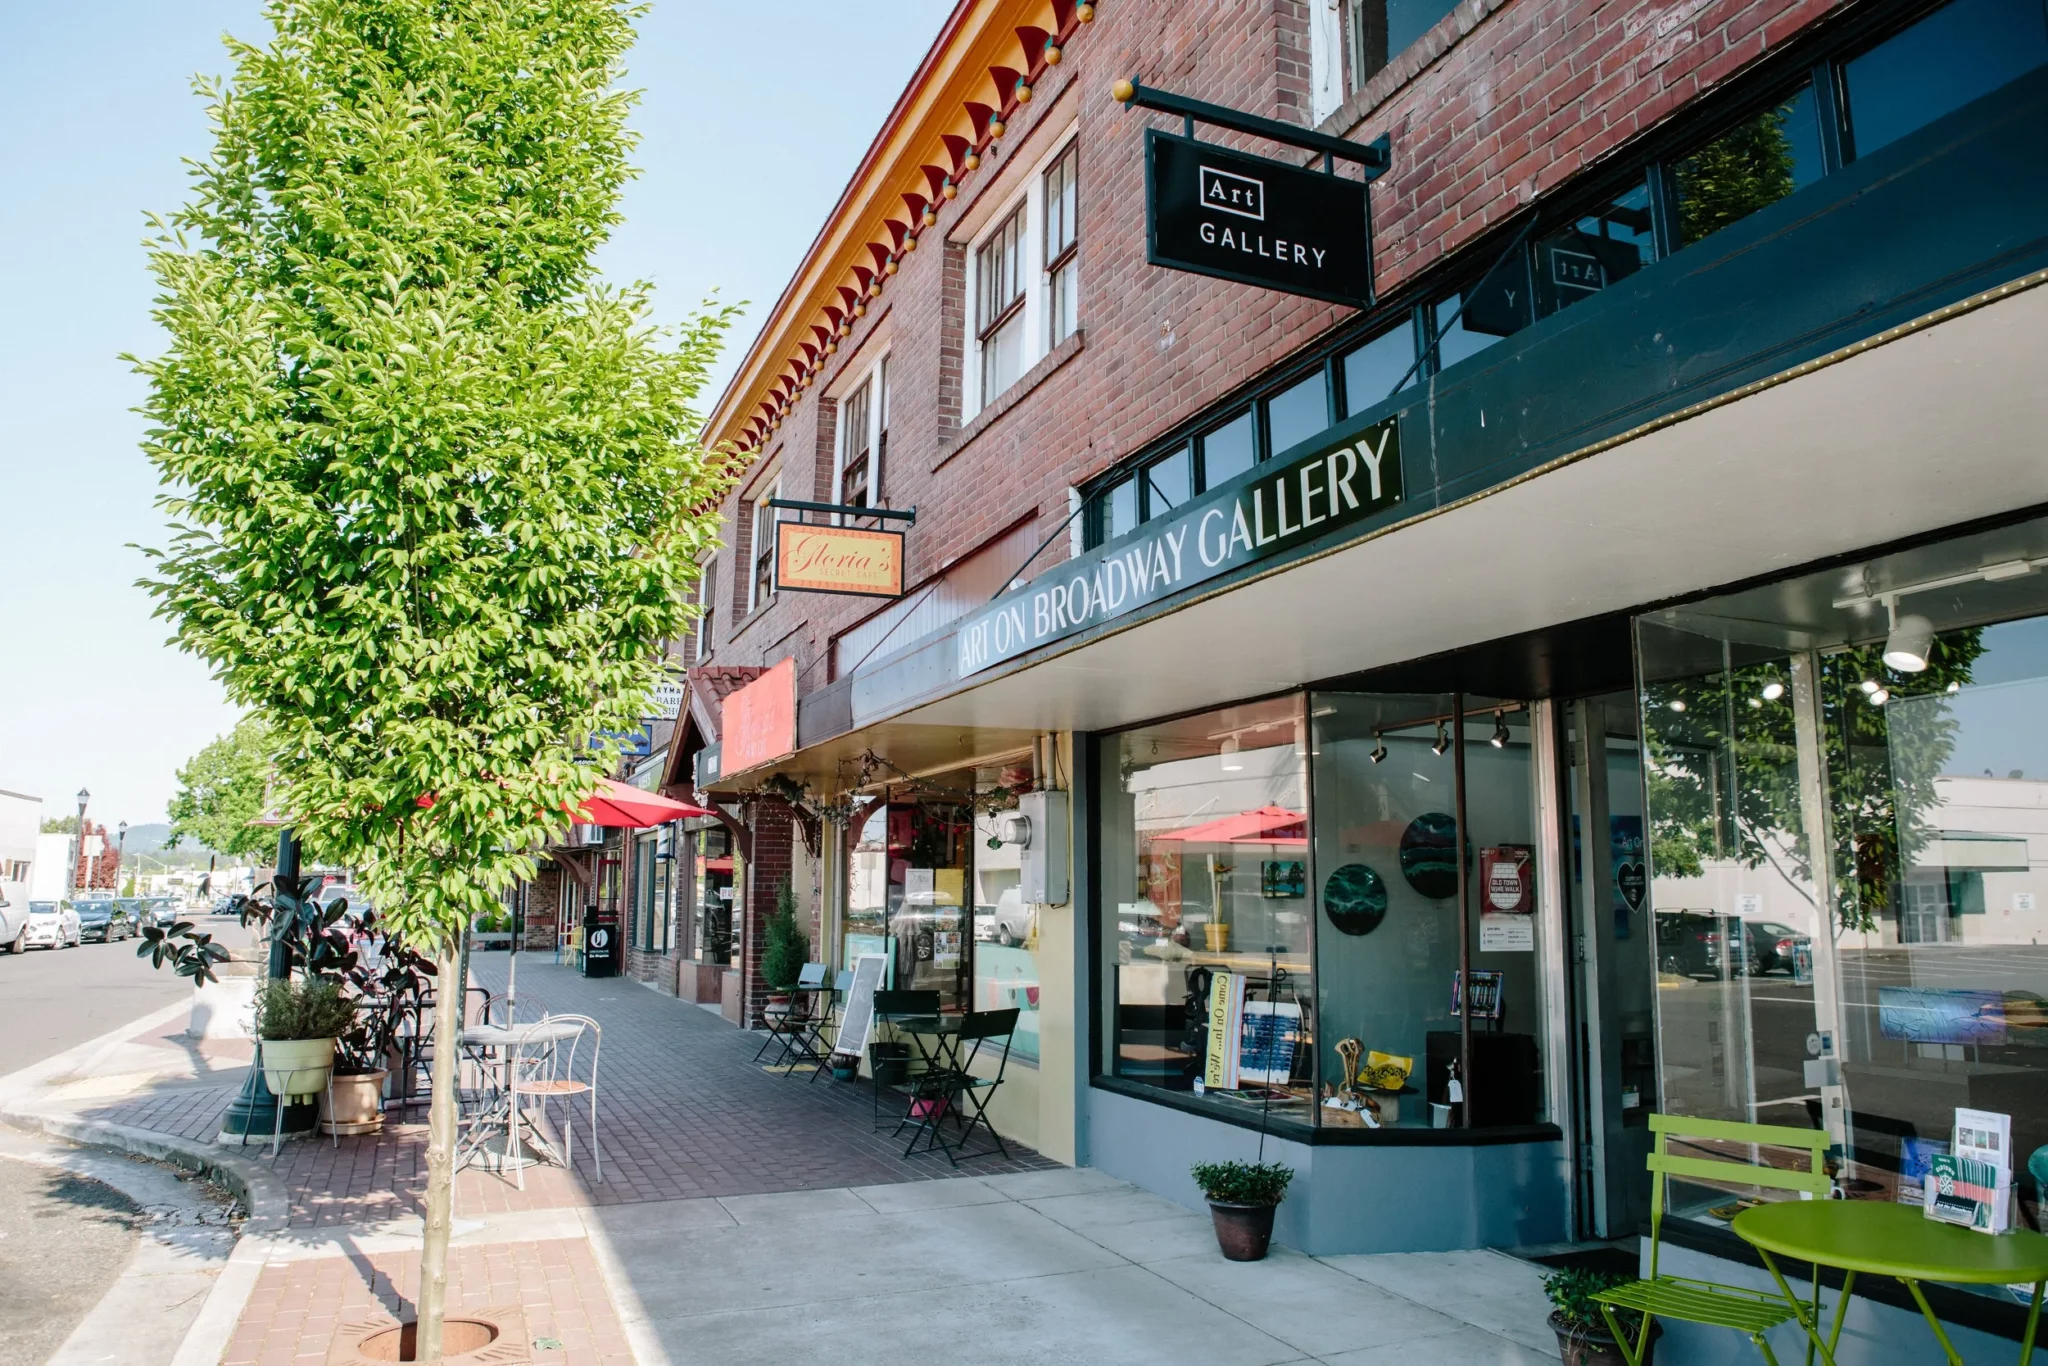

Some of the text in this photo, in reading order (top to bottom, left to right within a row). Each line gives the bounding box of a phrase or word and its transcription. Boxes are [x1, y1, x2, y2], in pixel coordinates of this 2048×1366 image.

[1208, 178, 1254, 207] Art
[1200, 222, 1326, 268] GALLERY
[783, 533, 890, 573] Gloria's
[960, 427, 1391, 671] ART ON BROADWAY GALLERY
[819, 567, 852, 577] SECRET
[656, 686, 681, 695] AYMA
